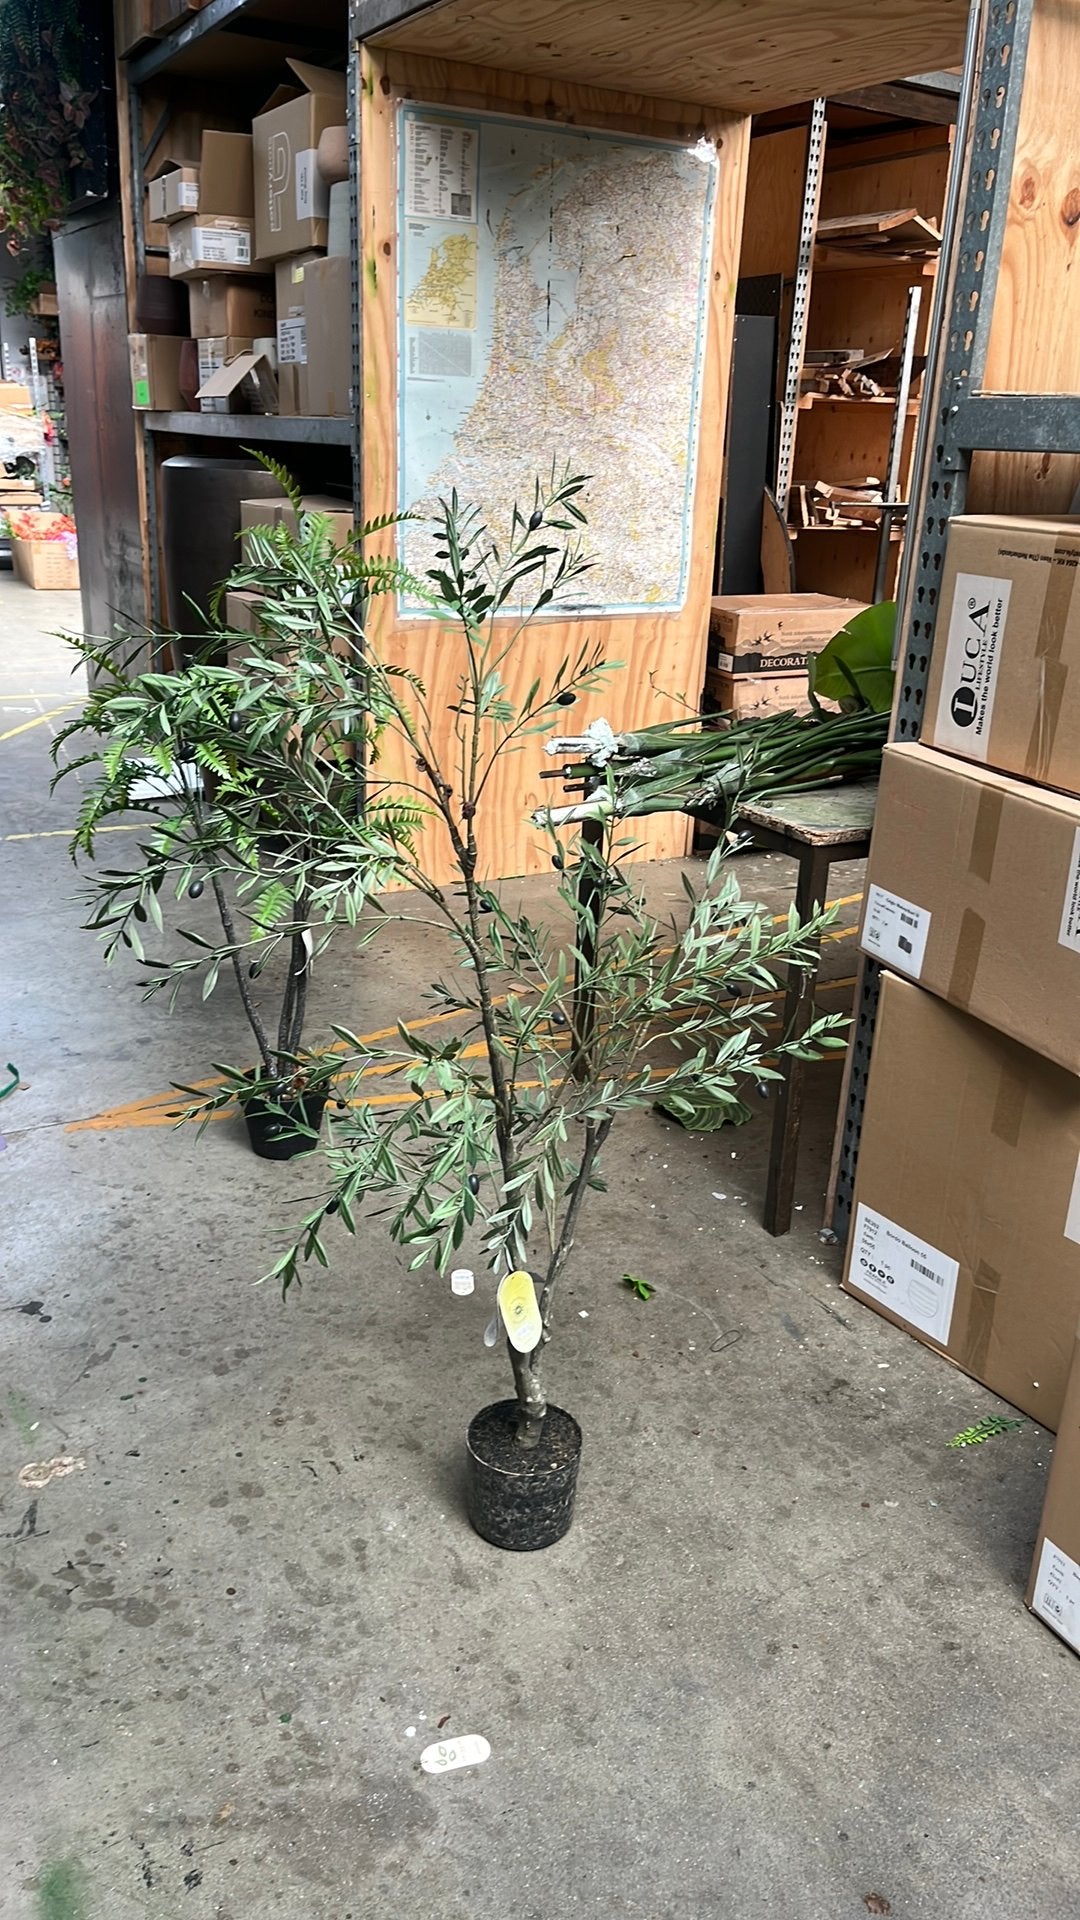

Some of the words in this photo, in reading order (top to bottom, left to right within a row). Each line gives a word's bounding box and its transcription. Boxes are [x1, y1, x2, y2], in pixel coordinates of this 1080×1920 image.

[992, 598, 1003, 629] better
[989, 631, 998, 653] look
[975, 639, 989, 691] LIFESTYLE
[985, 655, 994, 683] world
[981, 685, 989, 702] the
[975, 703, 987, 735] Makes
[1066, 917, 1074, 937] better
